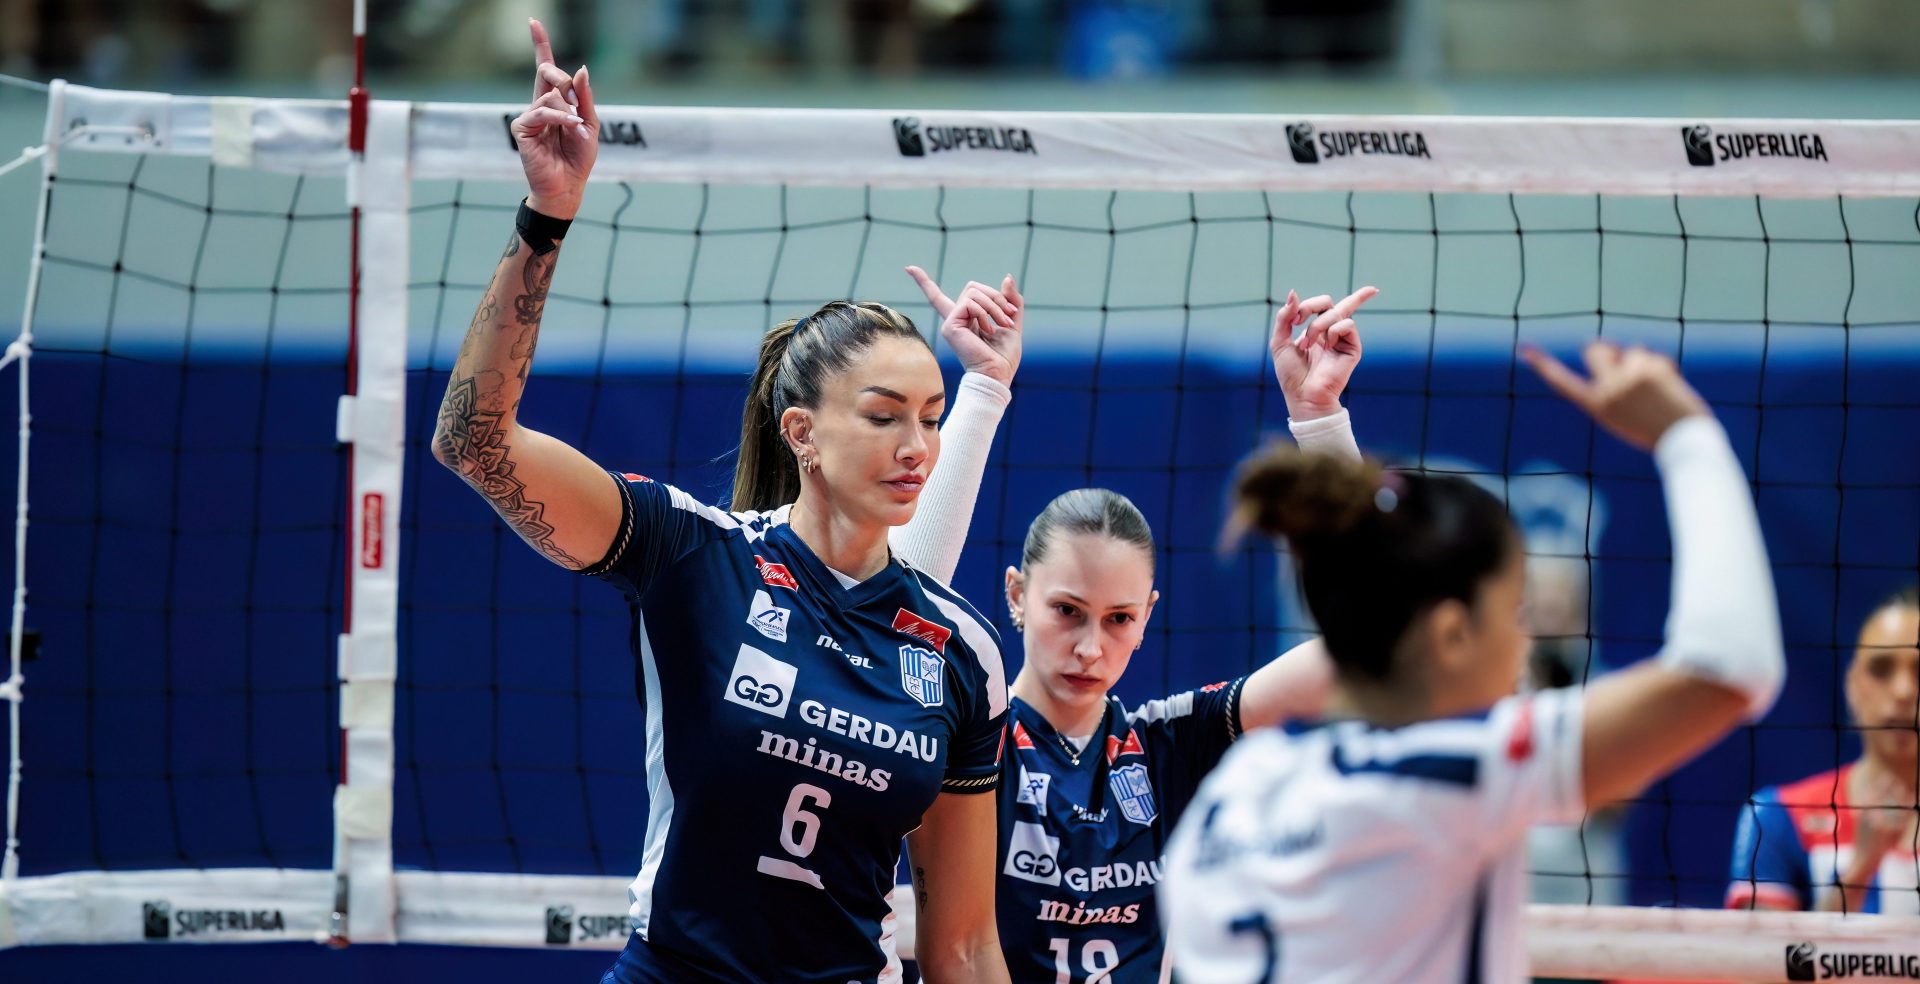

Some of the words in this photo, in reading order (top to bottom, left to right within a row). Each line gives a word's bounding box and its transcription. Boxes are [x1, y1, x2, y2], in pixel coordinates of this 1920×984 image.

[926, 126, 1039, 156] SUPERLIGA
[1318, 130, 1432, 160] SUPERLIGA
[1715, 132, 1829, 163] SUPERLIGA
[799, 699, 938, 763] GERDAU
[756, 729, 893, 792] minas
[779, 783, 832, 858] 6
[175, 908, 285, 935] SUPERLIGA
[1036, 899, 1141, 926] minas
[578, 914, 634, 942] SUPE
[1048, 937, 1120, 984] 18
[1819, 952, 1920, 980] SUPERLIG
